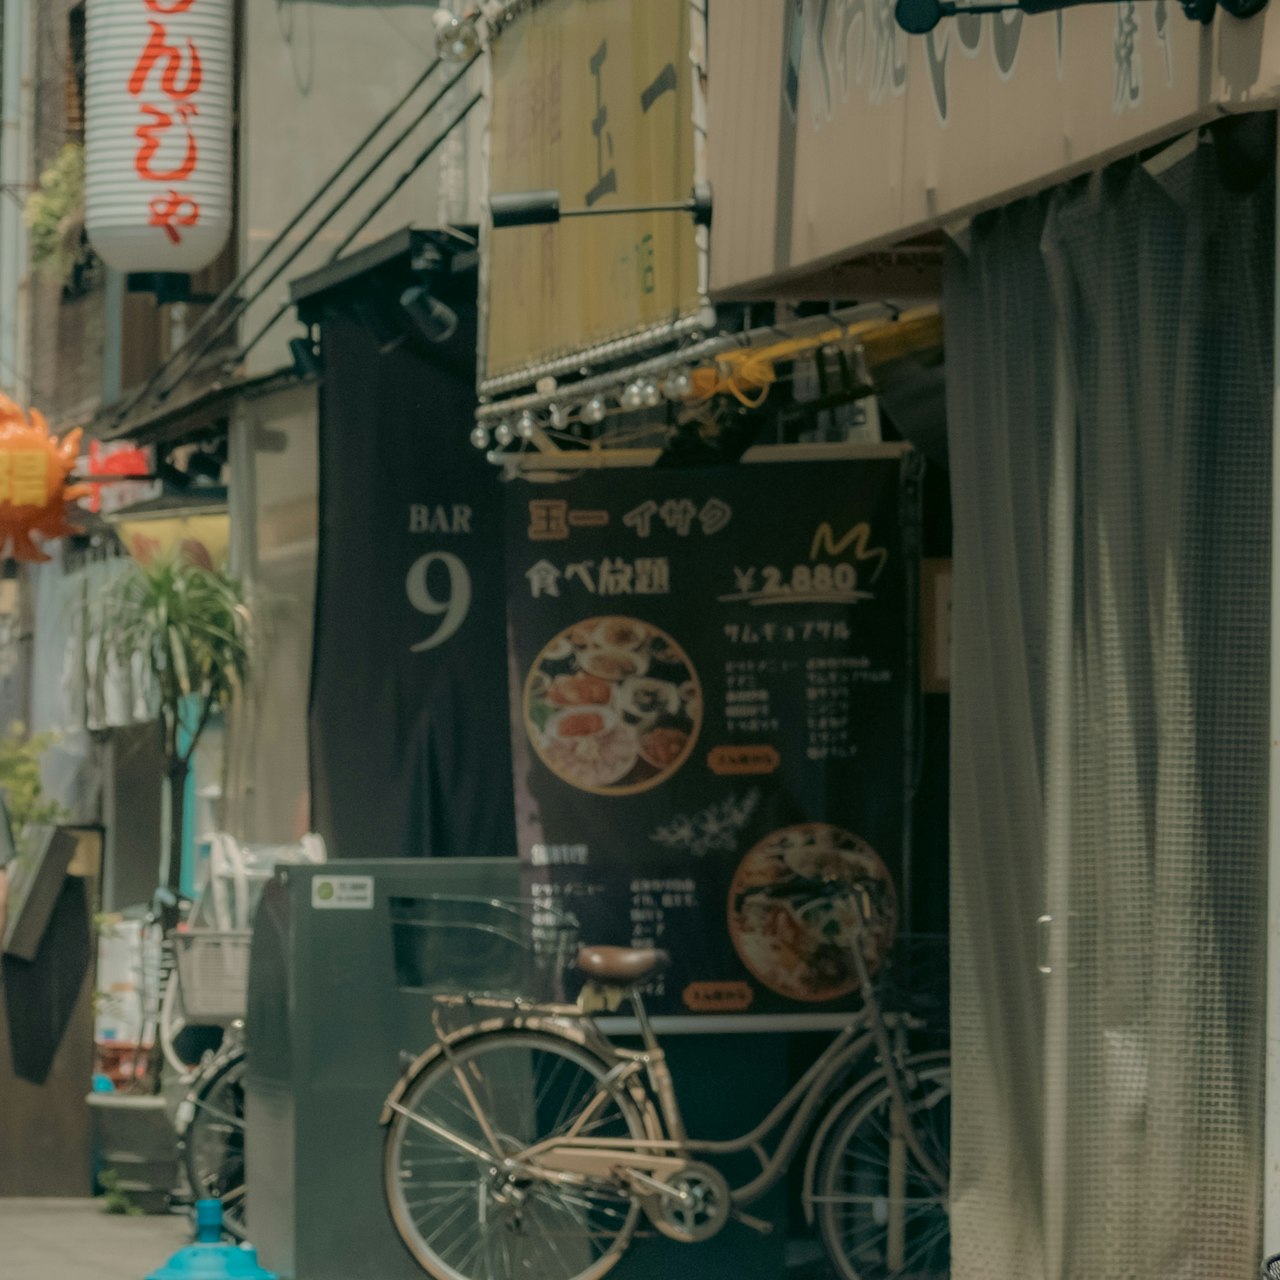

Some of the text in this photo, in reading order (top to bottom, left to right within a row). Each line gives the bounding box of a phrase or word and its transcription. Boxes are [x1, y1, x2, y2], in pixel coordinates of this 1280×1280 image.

[127, 0, 204, 246] んじゃ
[409, 504, 473, 533] BAR
[405, 551, 472, 653] 9
[524, 556, 670, 598] 食べ放題
